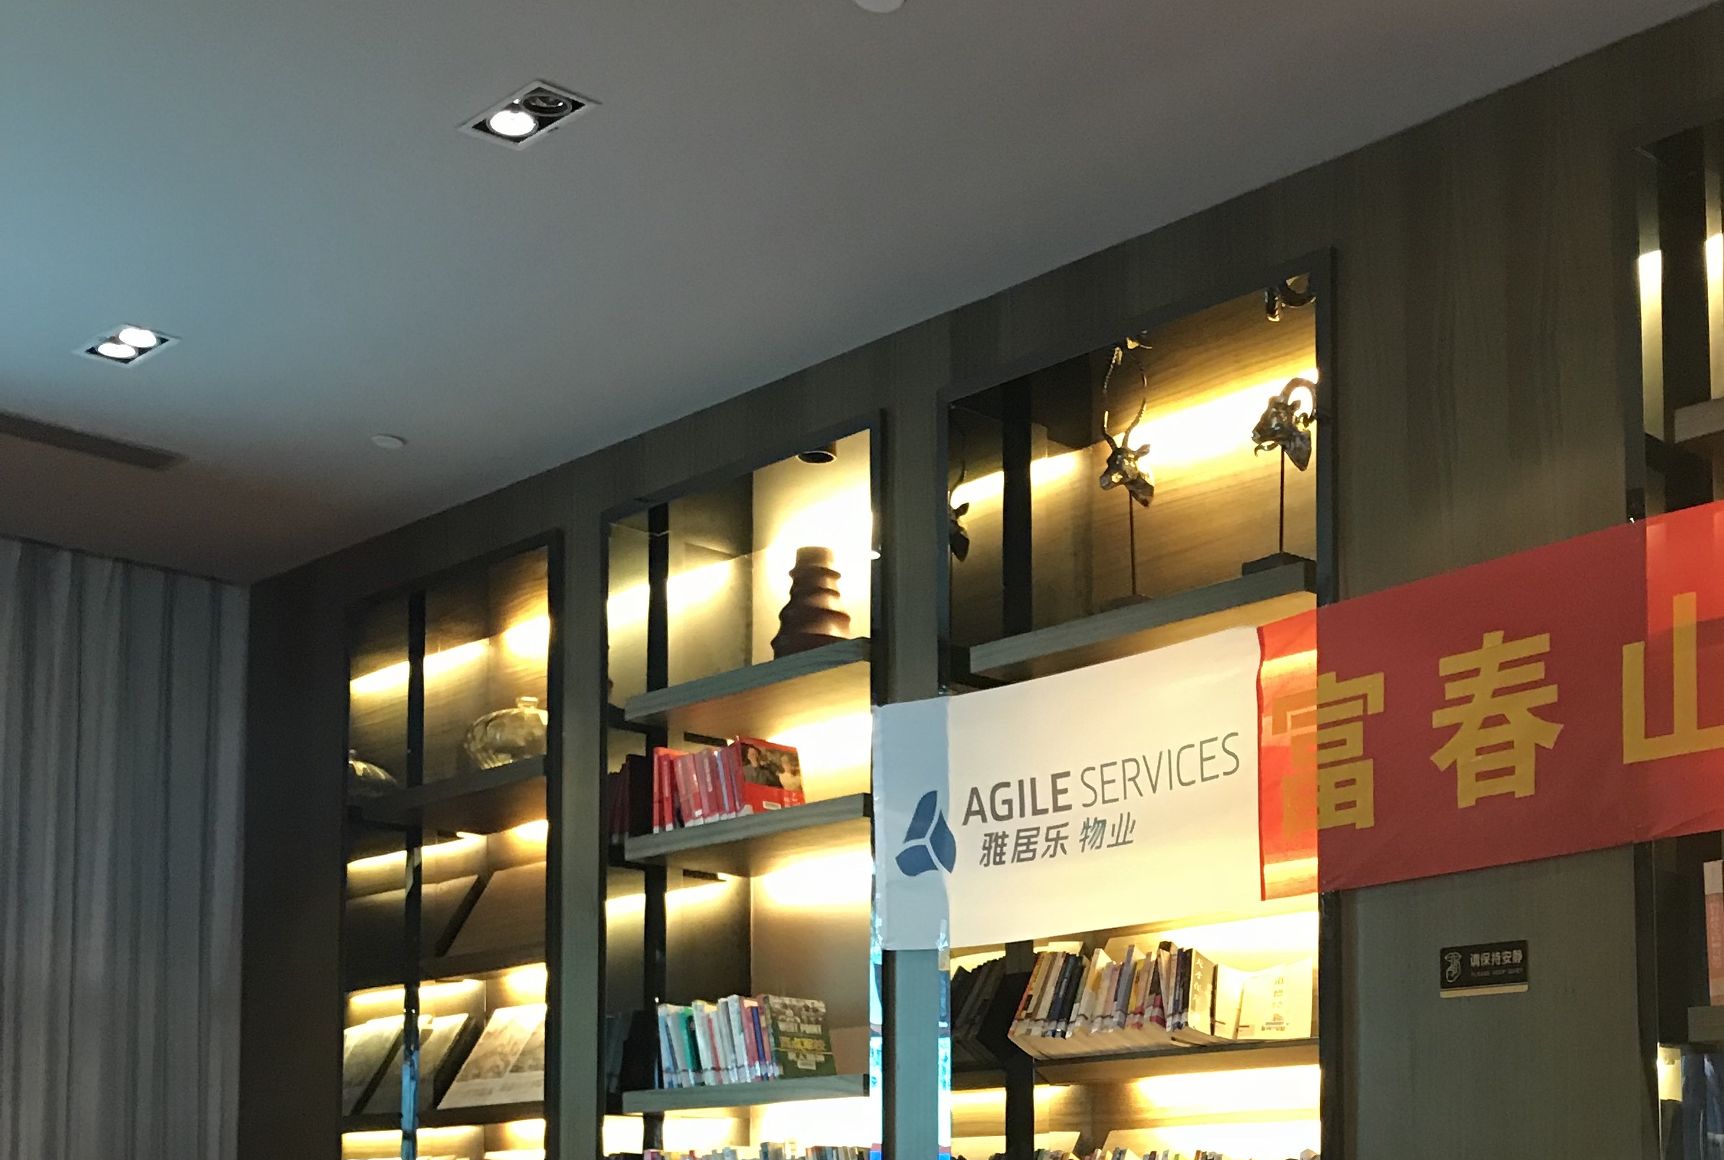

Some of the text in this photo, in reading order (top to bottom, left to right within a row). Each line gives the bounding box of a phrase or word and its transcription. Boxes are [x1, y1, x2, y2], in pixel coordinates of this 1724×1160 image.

[962, 731, 1240, 826] AGILE SERVICES
[1271, 591, 1724, 839] 富春山
